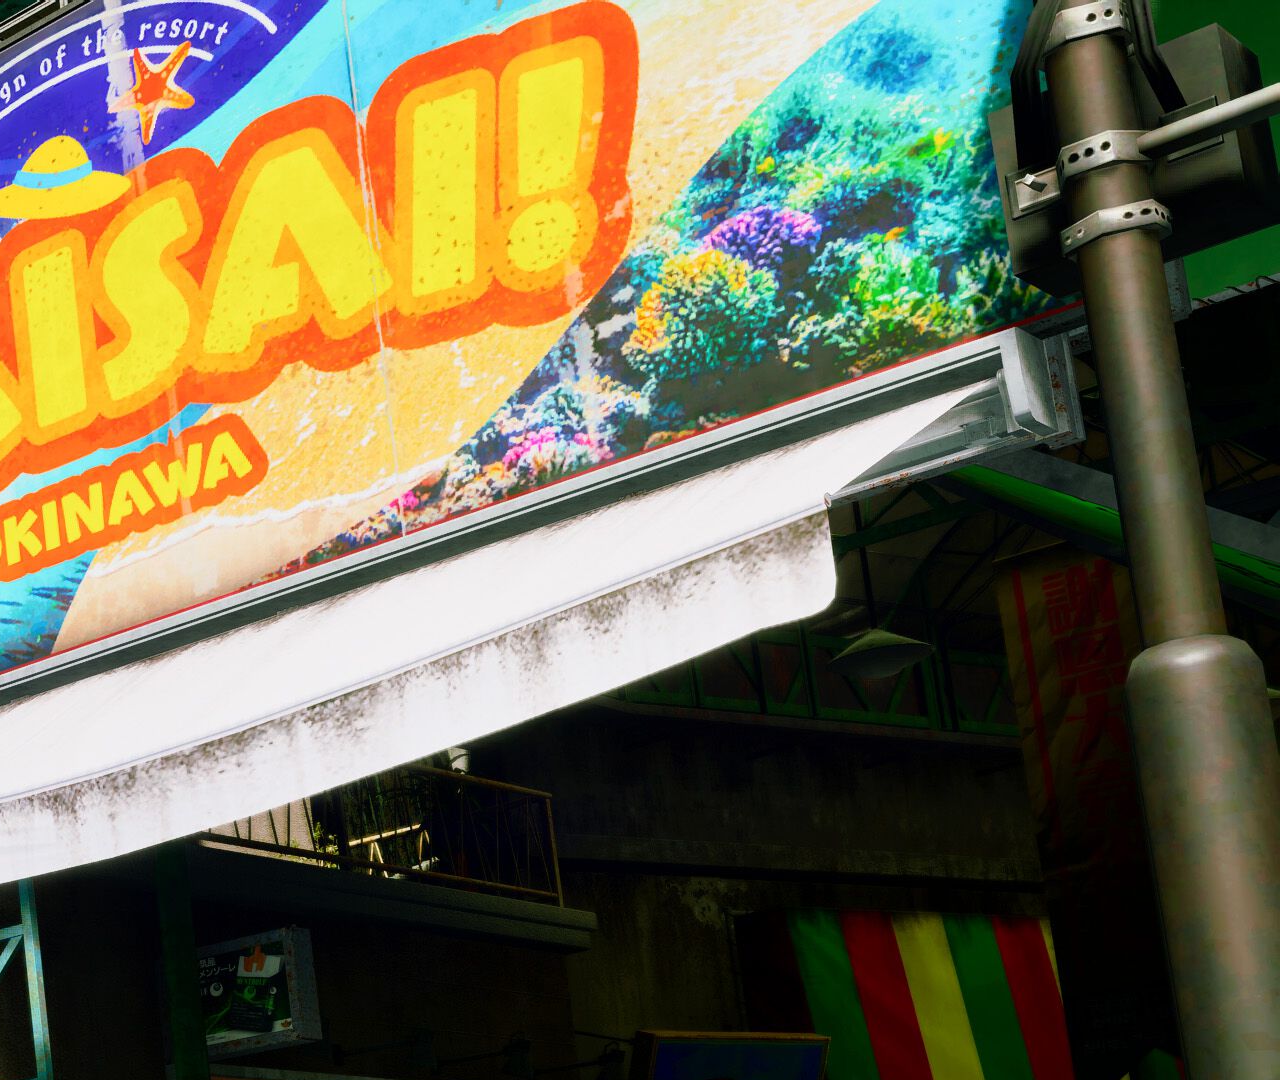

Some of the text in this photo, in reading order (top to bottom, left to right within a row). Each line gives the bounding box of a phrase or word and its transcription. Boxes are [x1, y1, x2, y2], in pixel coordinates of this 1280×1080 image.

[40, 43, 68, 77] of
[81, 25, 123, 57] the
[138, 18, 229, 46] resort
